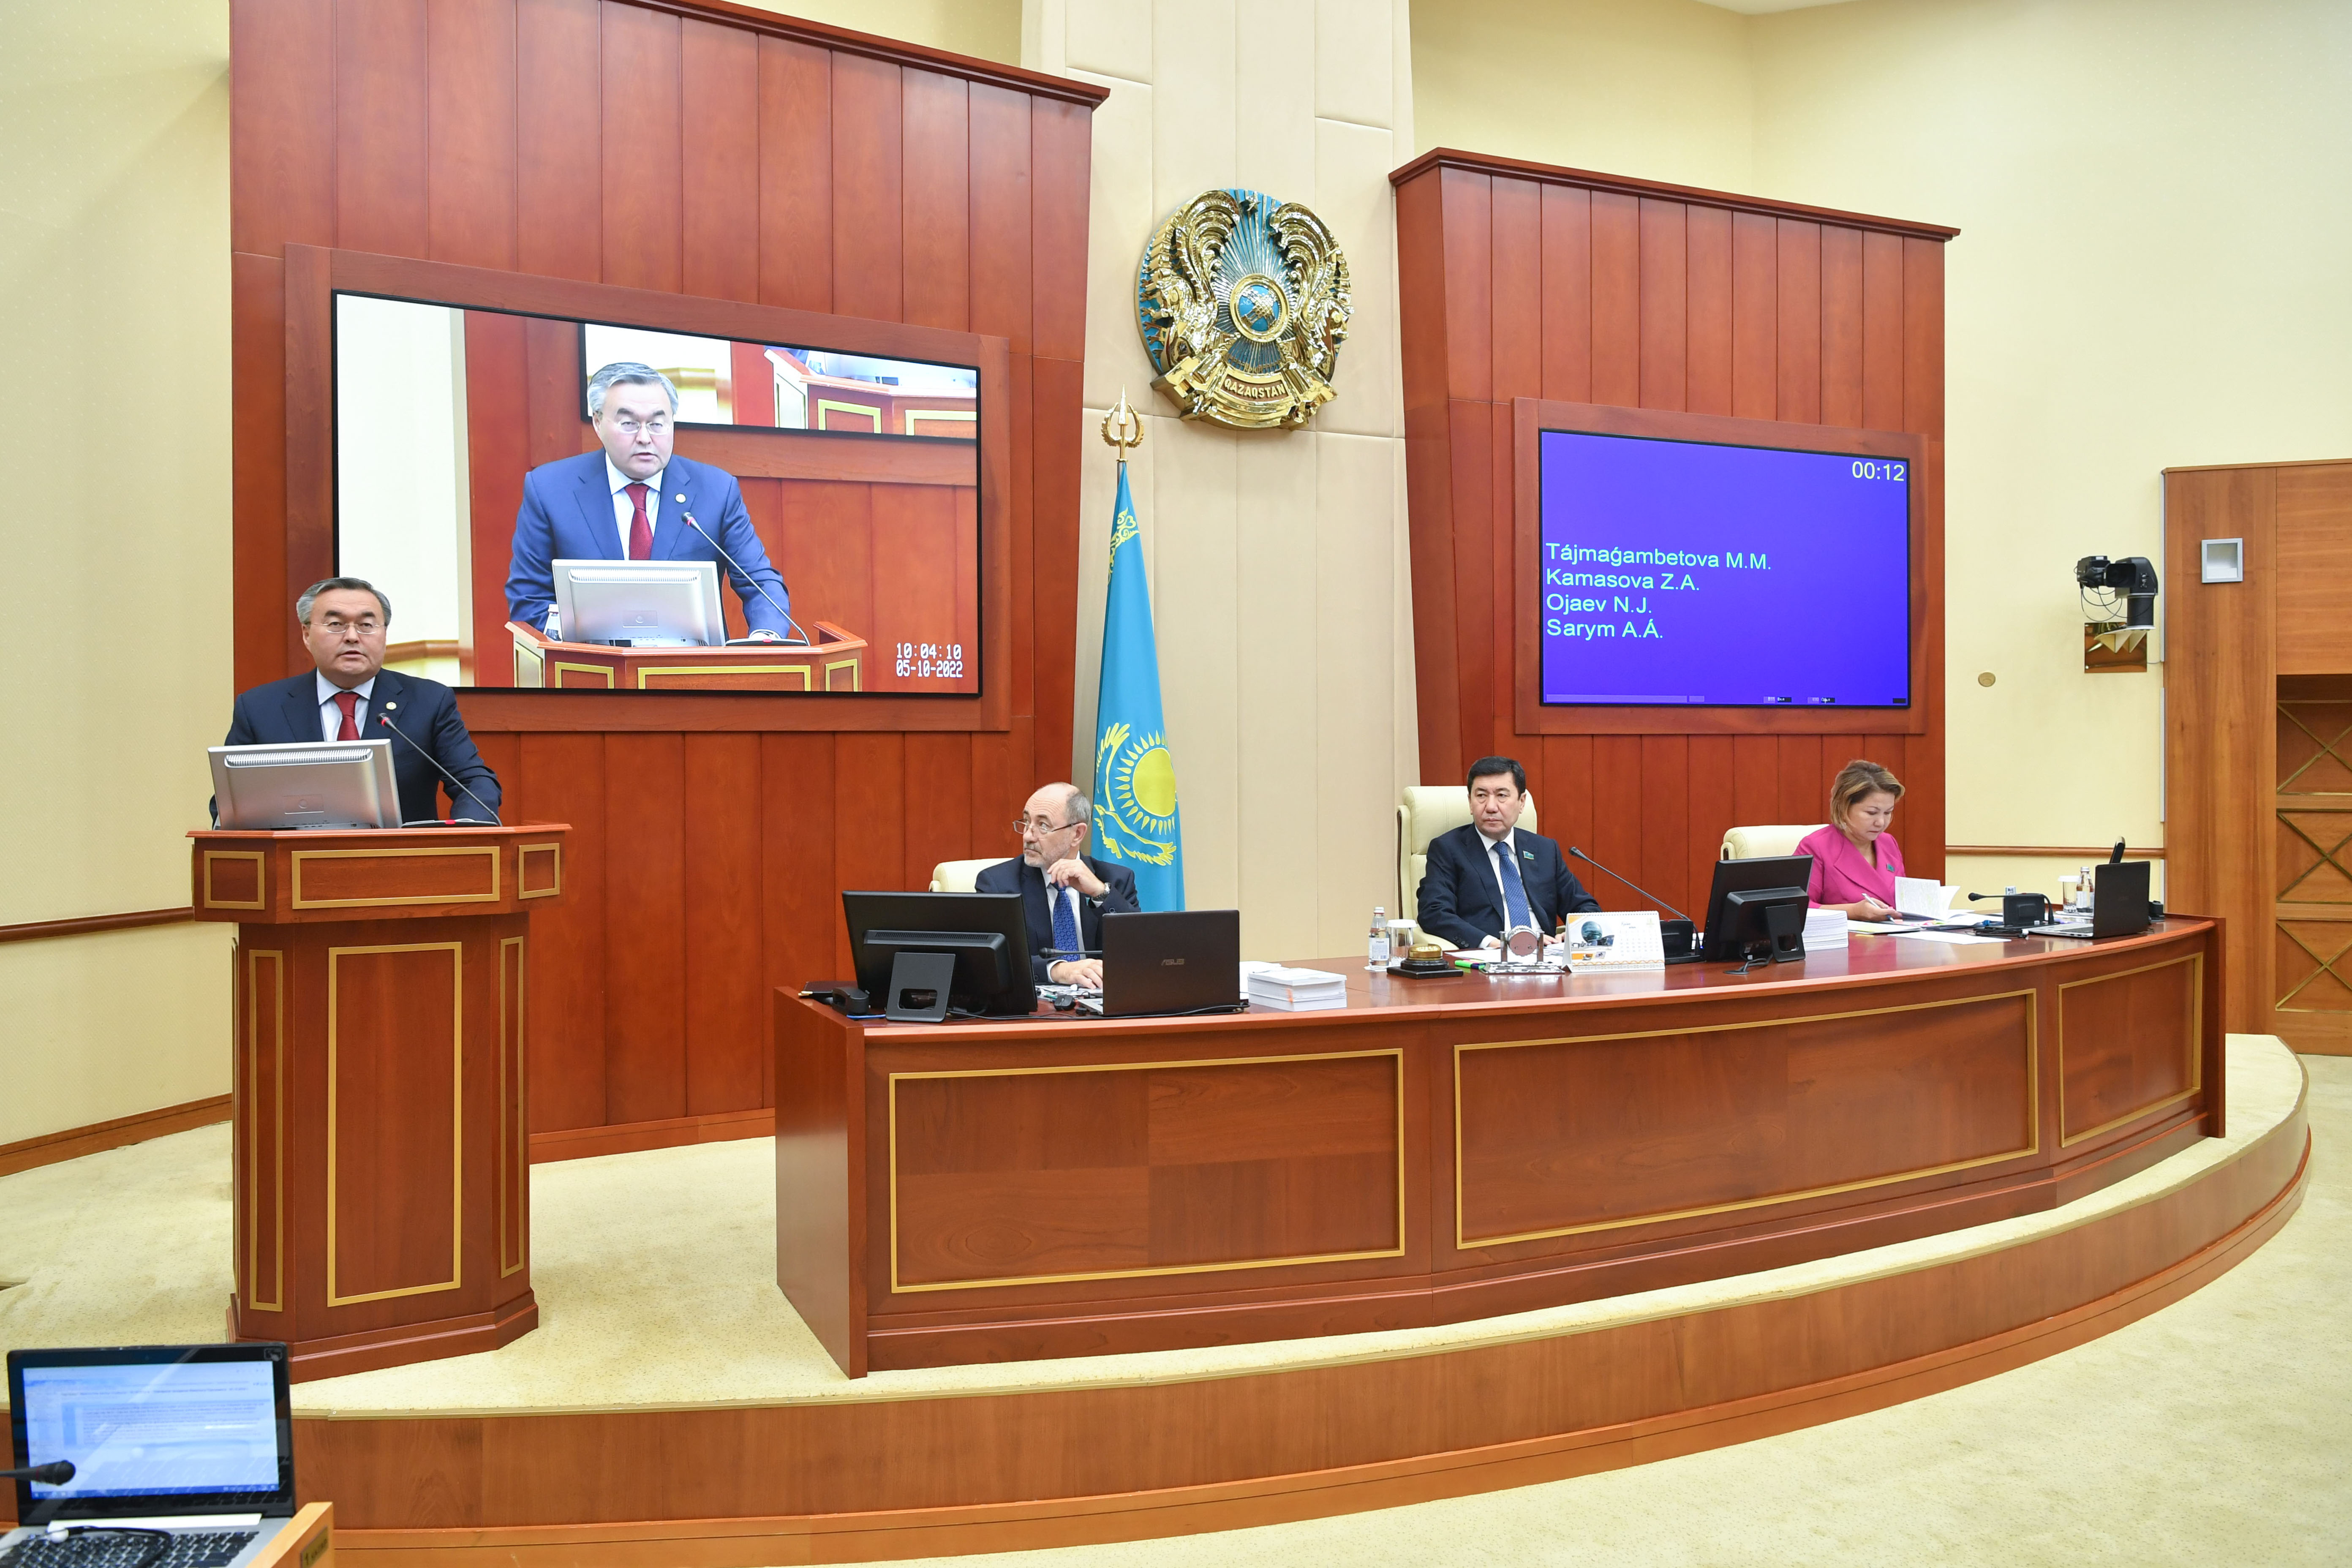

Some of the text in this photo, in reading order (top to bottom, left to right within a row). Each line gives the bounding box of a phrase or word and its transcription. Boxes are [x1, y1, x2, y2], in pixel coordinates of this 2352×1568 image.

[1224, 378, 1286, 399] QAZAQSTAN
[1852, 461, 1906, 482] 00:12
[1726, 552, 1771, 570] M.M.
[1546, 568, 1699, 591] Kamasova Z.A.
[1546, 593, 1652, 615] Ojaev N.J.
[1546, 618, 1663, 641] Sarym A.Á.
[896, 642, 962, 660] 10:04:10
[896, 659, 964, 678] 05-10-2022
[1161, 958, 1184, 966] ASUS
